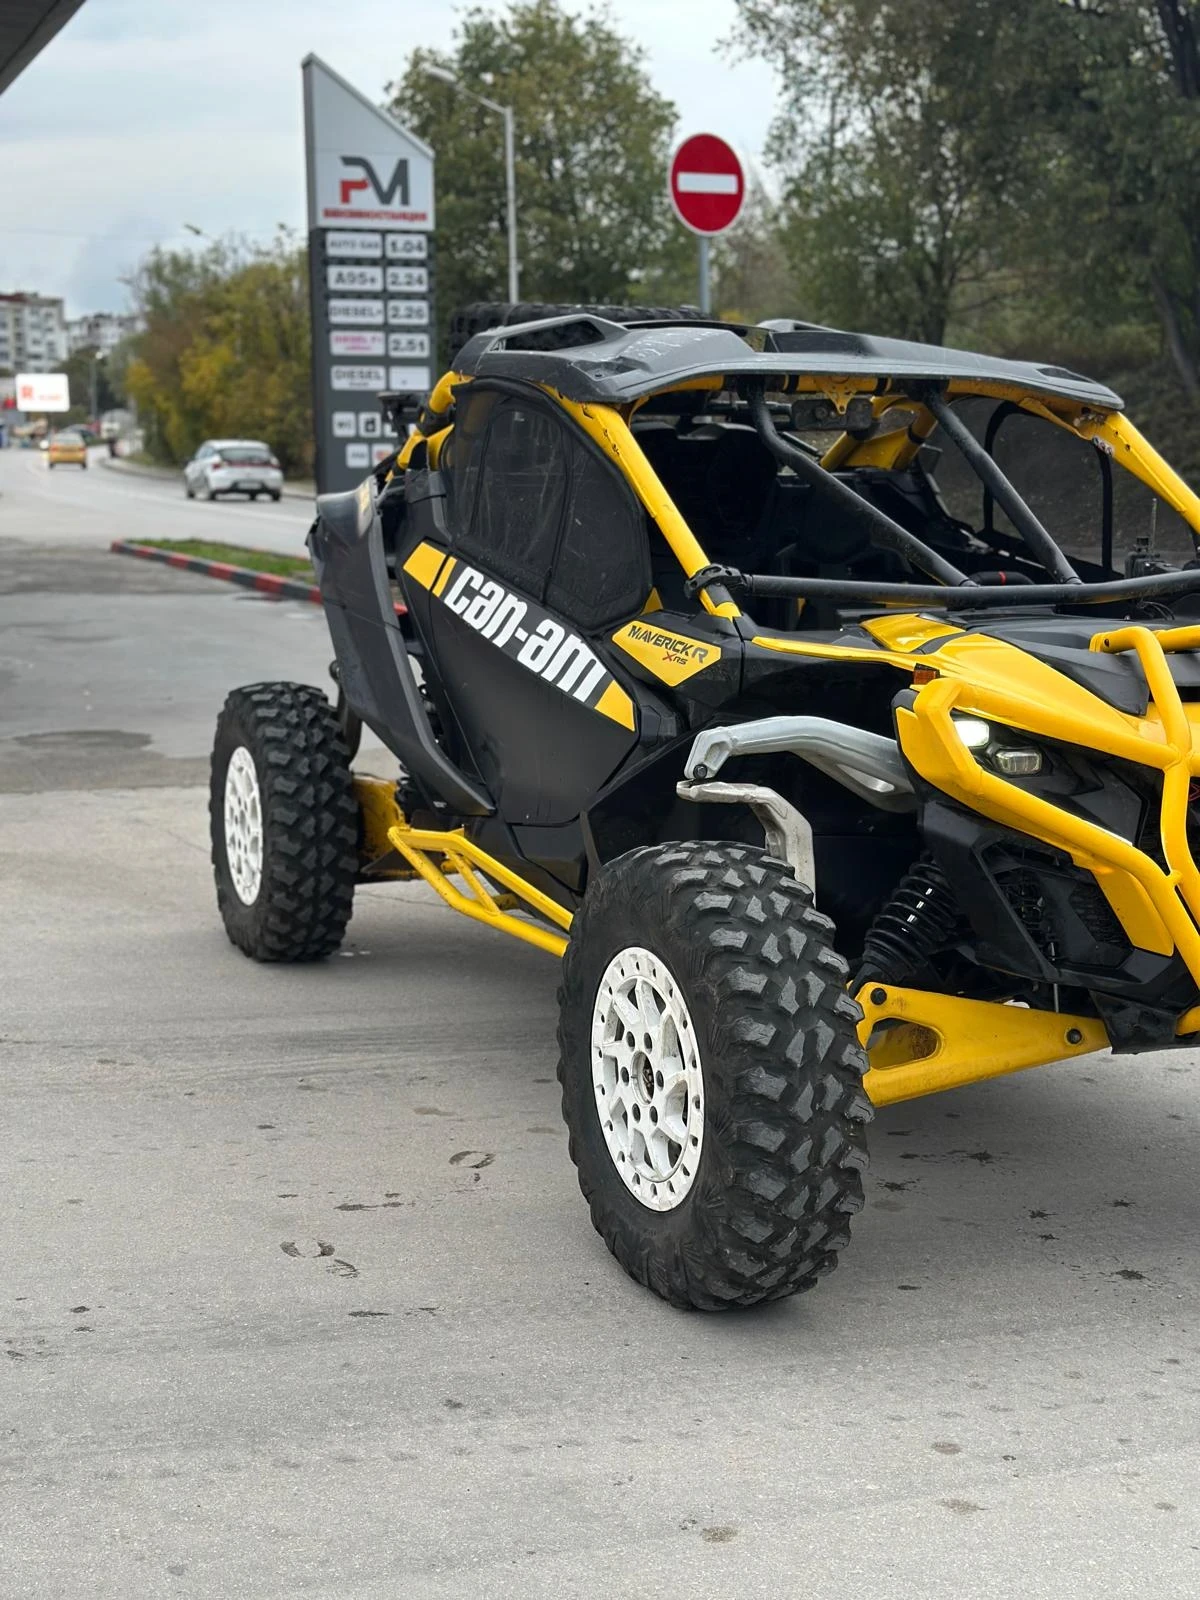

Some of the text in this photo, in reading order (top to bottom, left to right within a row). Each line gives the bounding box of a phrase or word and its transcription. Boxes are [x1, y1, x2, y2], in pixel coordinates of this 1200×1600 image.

[390, 240, 424, 253] 1.04
[335, 270, 376, 284] A95+
[390, 271, 424, 285] 2.24
[335, 369, 381, 380] DIESEL
[628, 625, 709, 664] MAVERICK R
